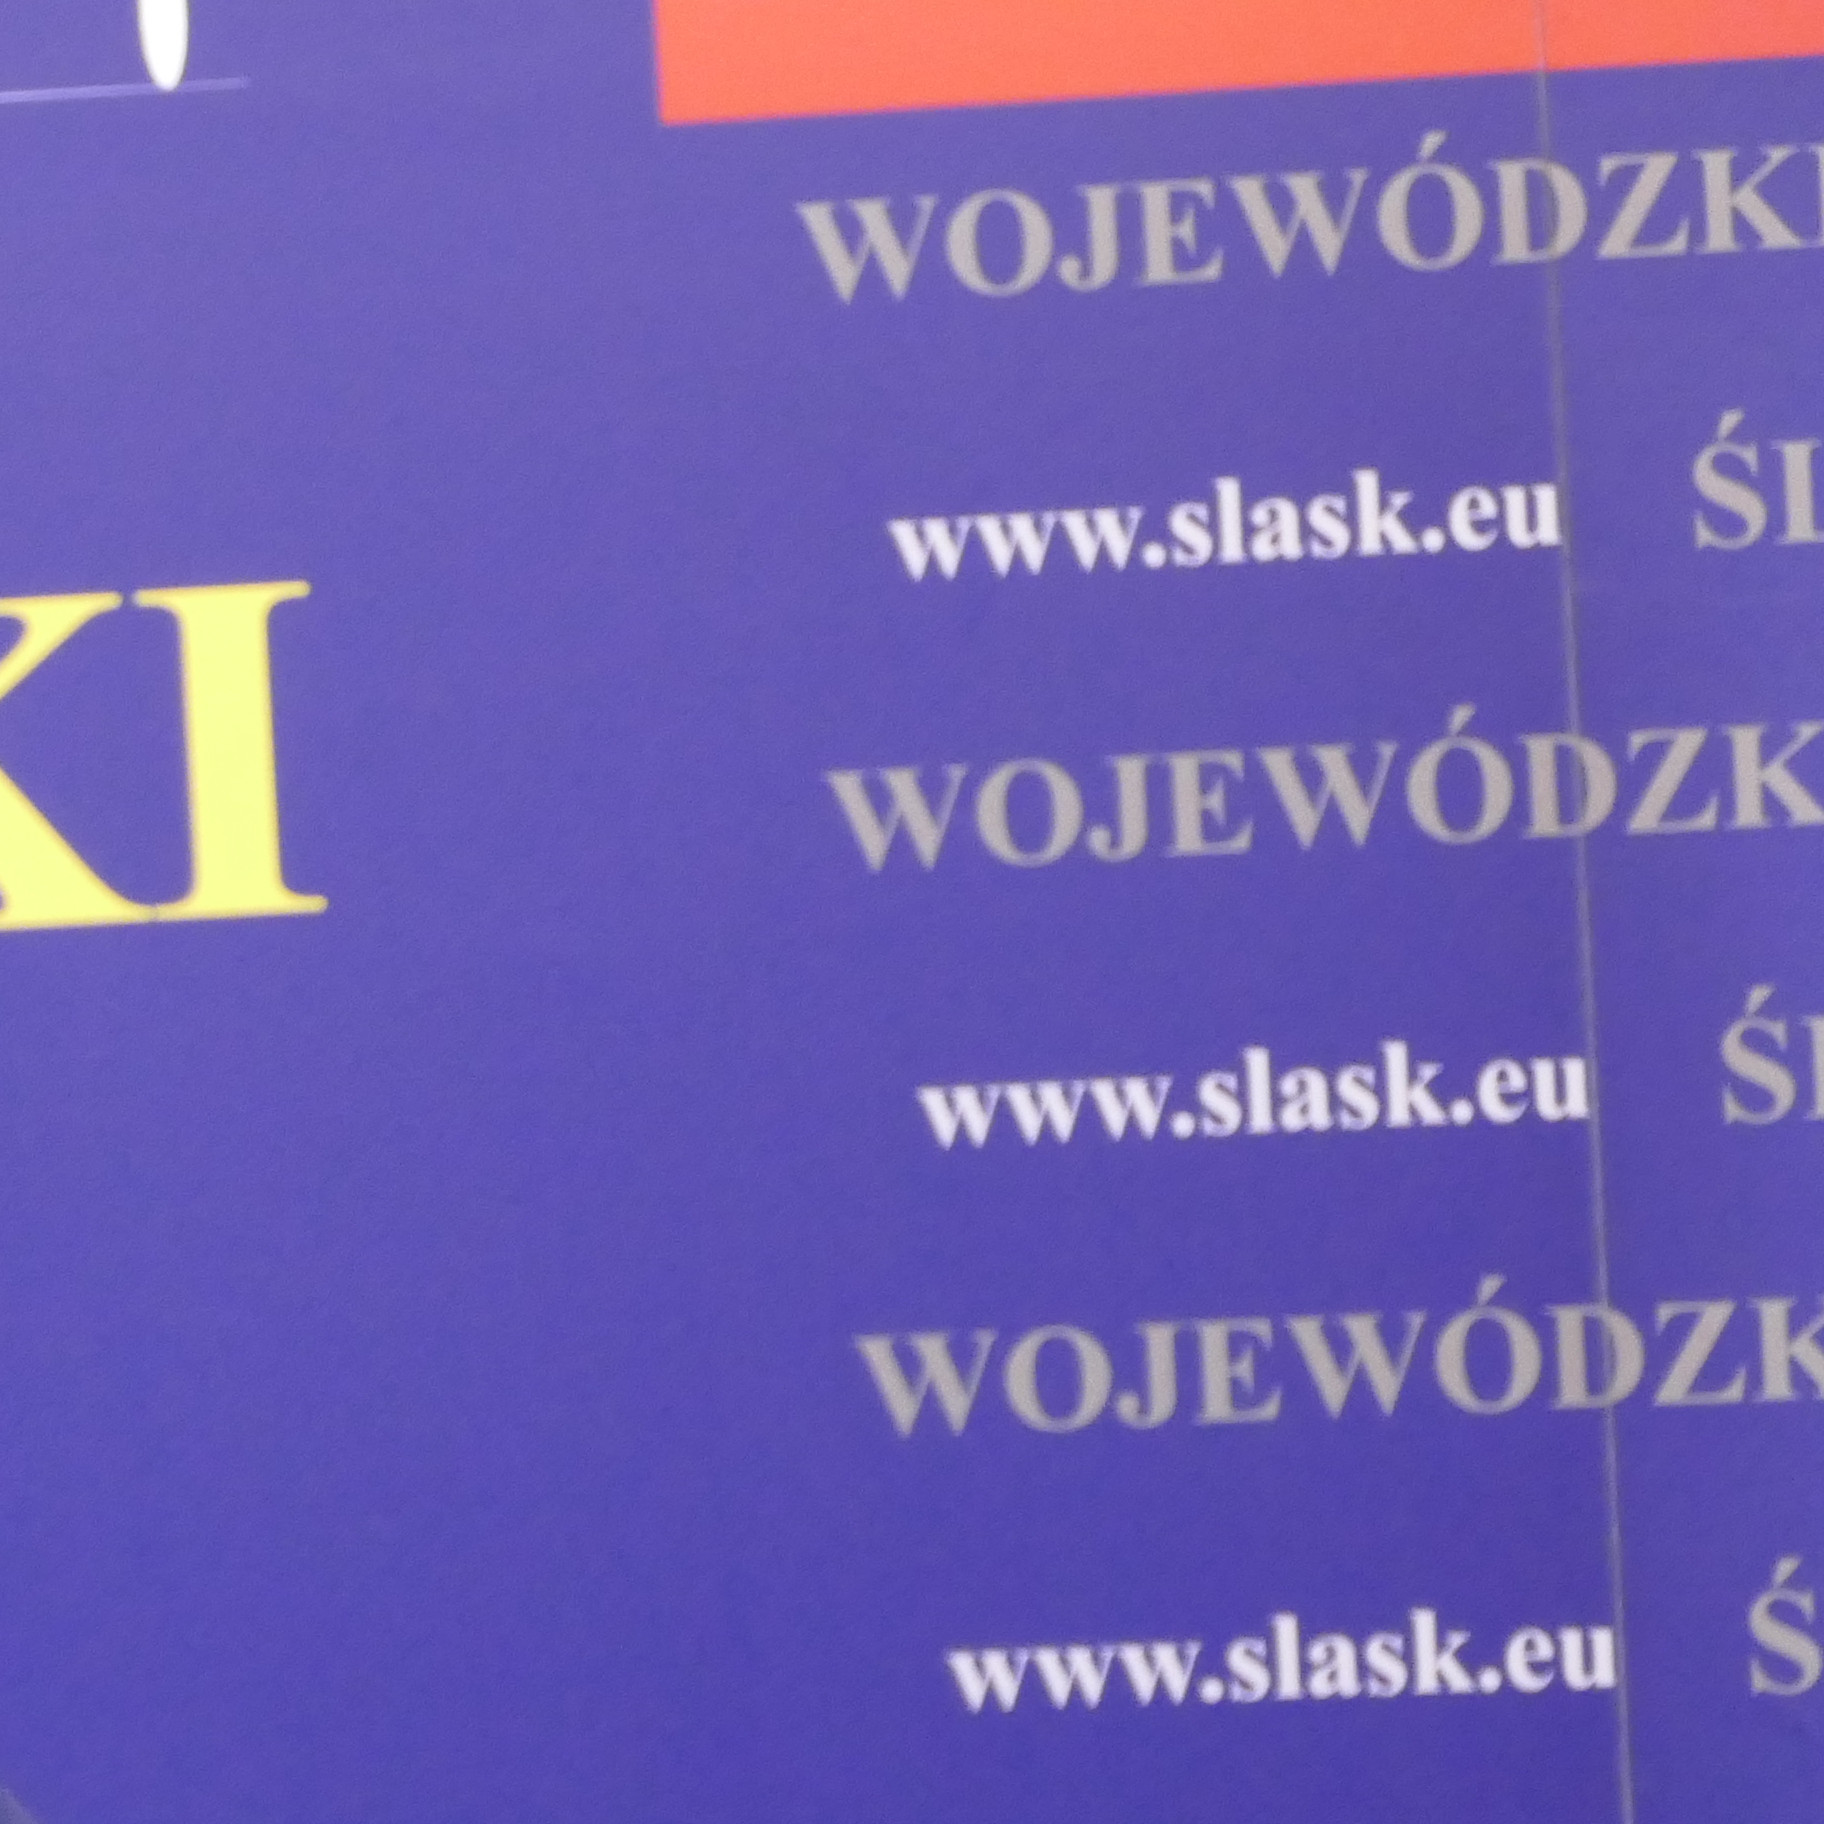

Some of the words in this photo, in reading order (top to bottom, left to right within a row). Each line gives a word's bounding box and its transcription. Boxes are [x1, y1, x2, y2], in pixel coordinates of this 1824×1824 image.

[888, 466, 1558, 580] www.slask.eu
[917, 1038, 1589, 1147] www.slask.eu
[946, 1607, 1617, 1712] www.slask.eu
